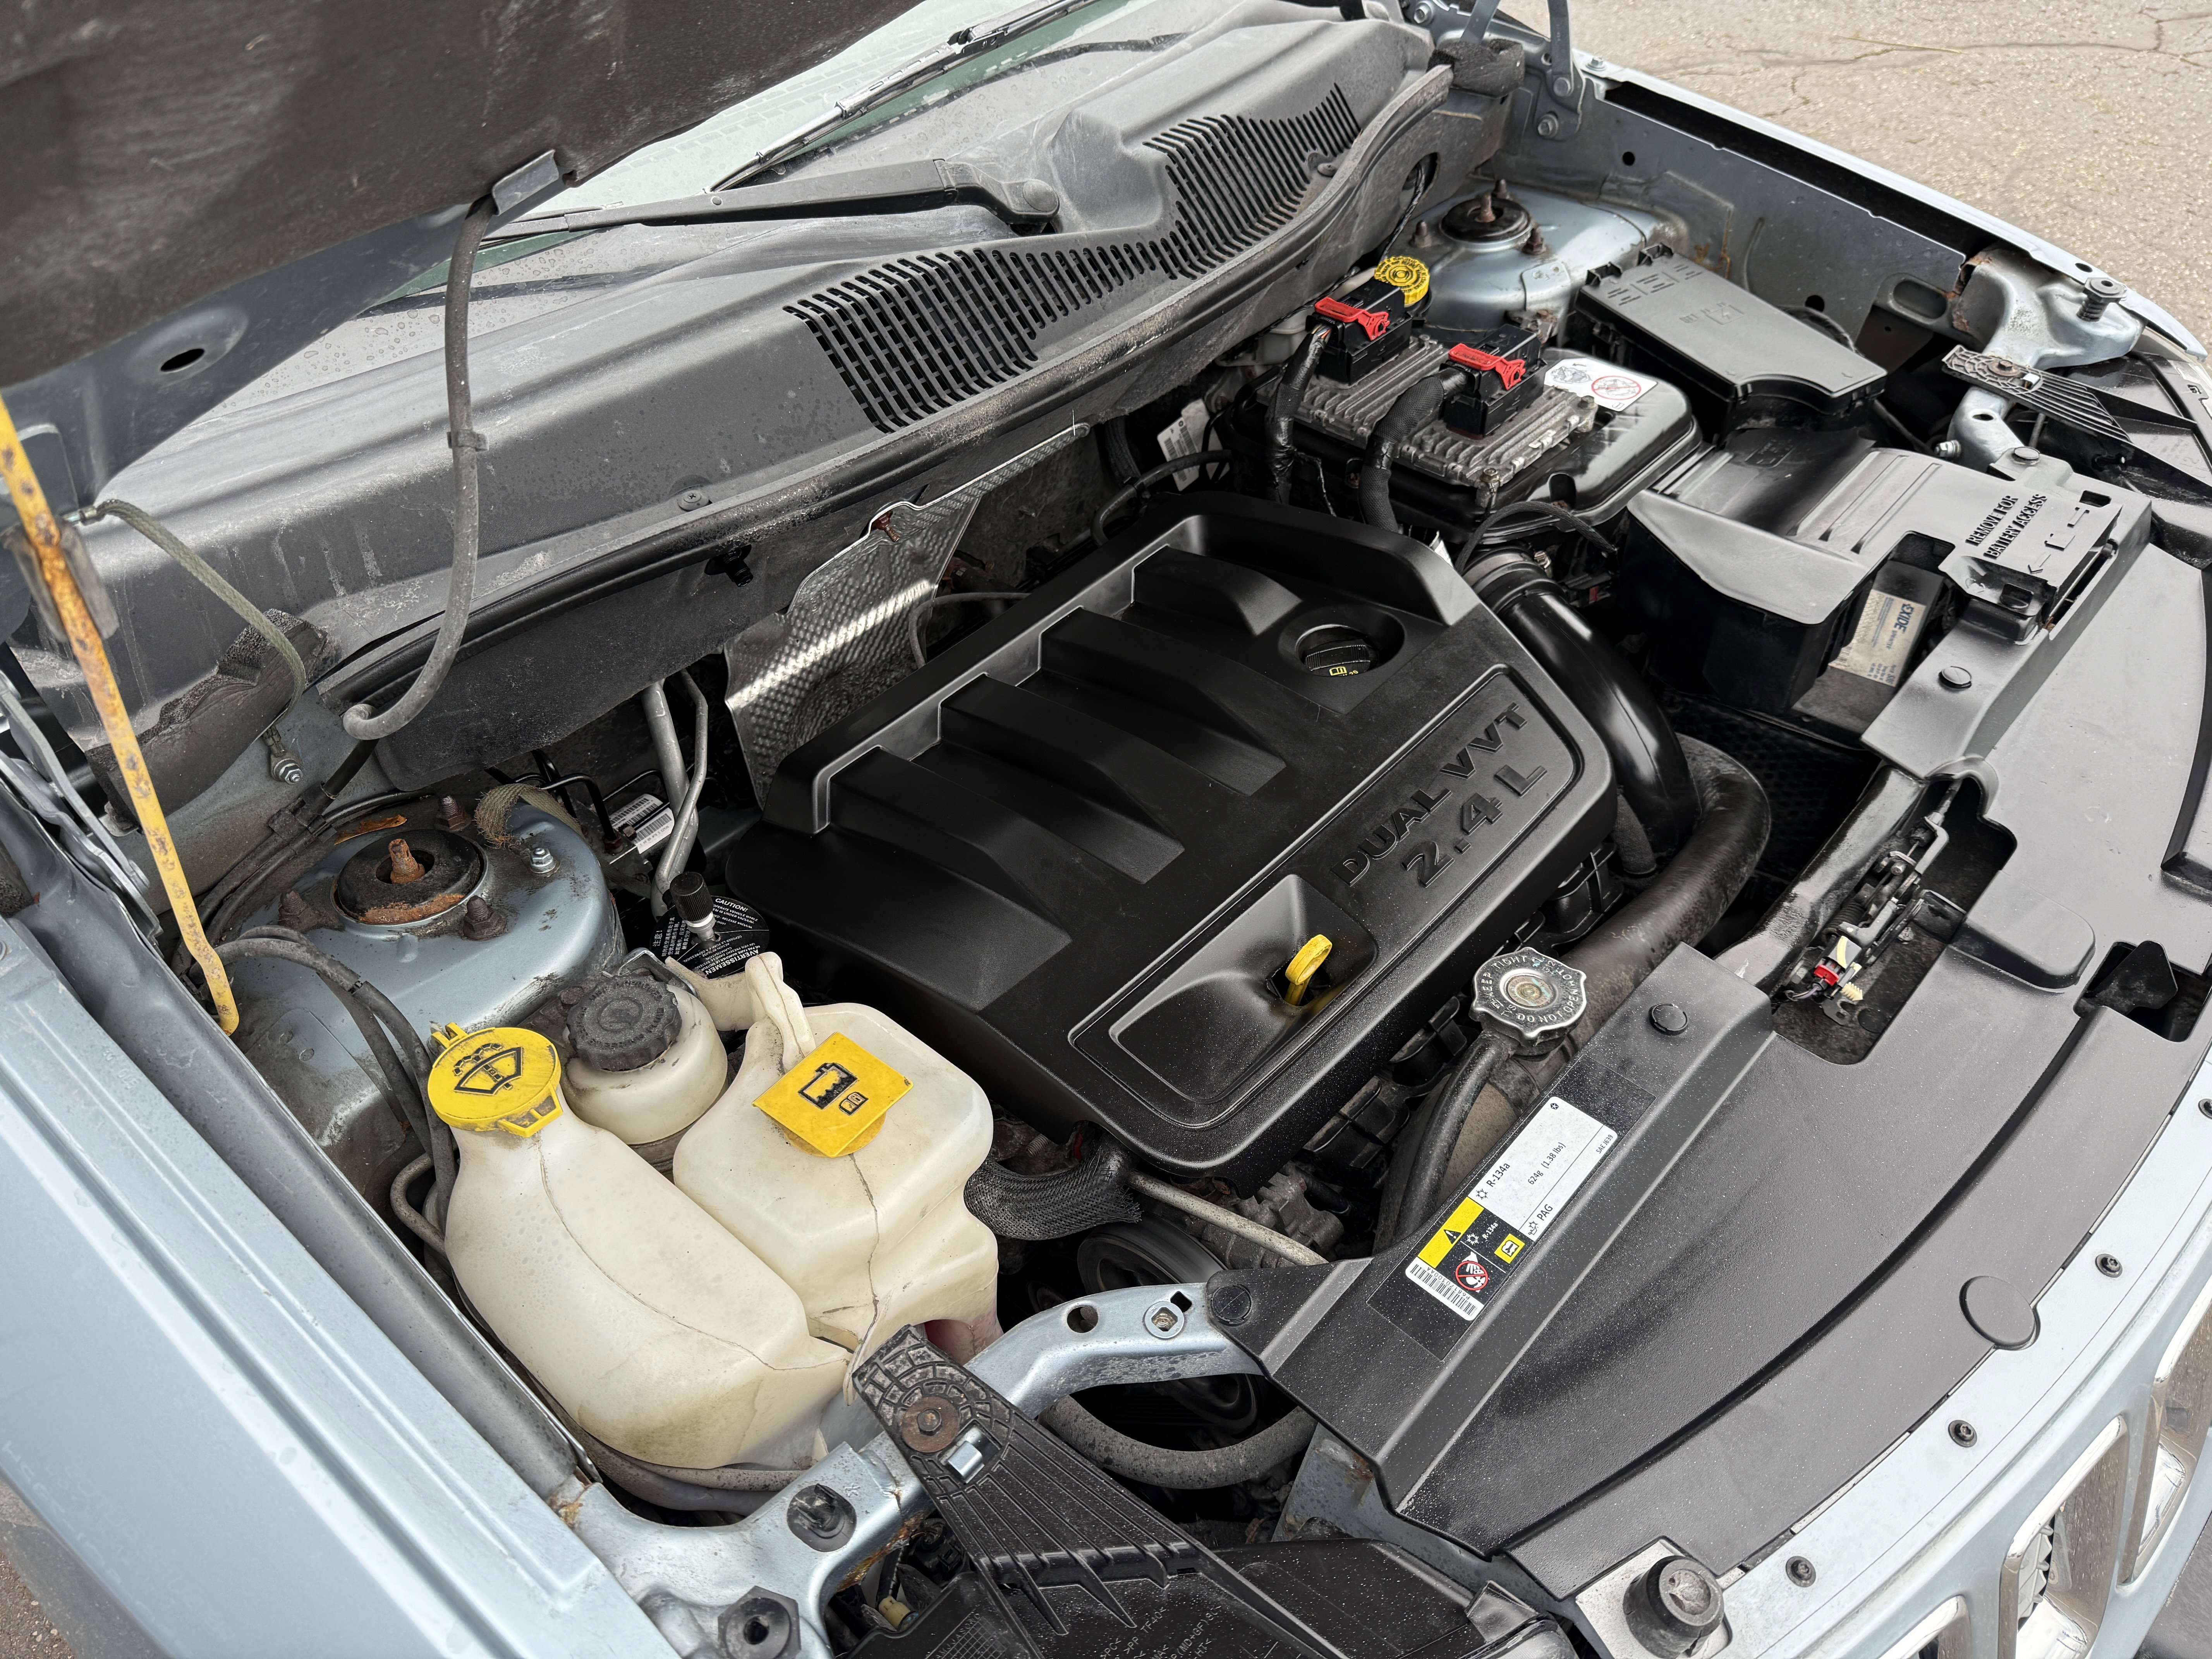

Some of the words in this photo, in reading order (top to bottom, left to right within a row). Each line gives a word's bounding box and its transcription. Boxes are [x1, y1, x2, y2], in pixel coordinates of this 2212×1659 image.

[1965, 512, 2004, 546] REMOVE
[1993, 496, 2019, 514] FOR
[1983, 524, 2021, 559] BATTERY
[2013, 493, 2049, 528] ACCESS
[1894, 603, 1915, 634] EXIDE
[1331, 788, 1451, 886] DUAL
[1440, 703, 1528, 778] VVT
[714, 897, 748, 912] CAUTION!
[729, 909, 745, 917] VEHICLE
[722, 916, 737, 924] RELEASE
[704, 948, 757, 975] AVERTISSEMEN
[1481, 972, 1494, 998] KEEP
[1491, 955, 1527, 969] TIGHT
[1501, 1004, 1516, 1016] TVS
[1516, 1013, 1535, 1022] DO
[1538, 1011, 1563, 1023] NOT
[1563, 989, 1578, 1012] OPEN
[1595, 1143, 1606, 1155] SAE
[1602, 1133, 1614, 1146] J639
[1487, 1161, 1511, 1188] R-134a
[1527, 1168, 1544, 1187] 624g
[1540, 1151, 1558, 1170] (1.38
[1552, 1140, 1566, 1156] lbs)
[1536, 1203, 1554, 1222] PAG
[1482, 1220, 1499, 1240] R-134a
[1426, 1266, 1470, 1300] P68170300AA
